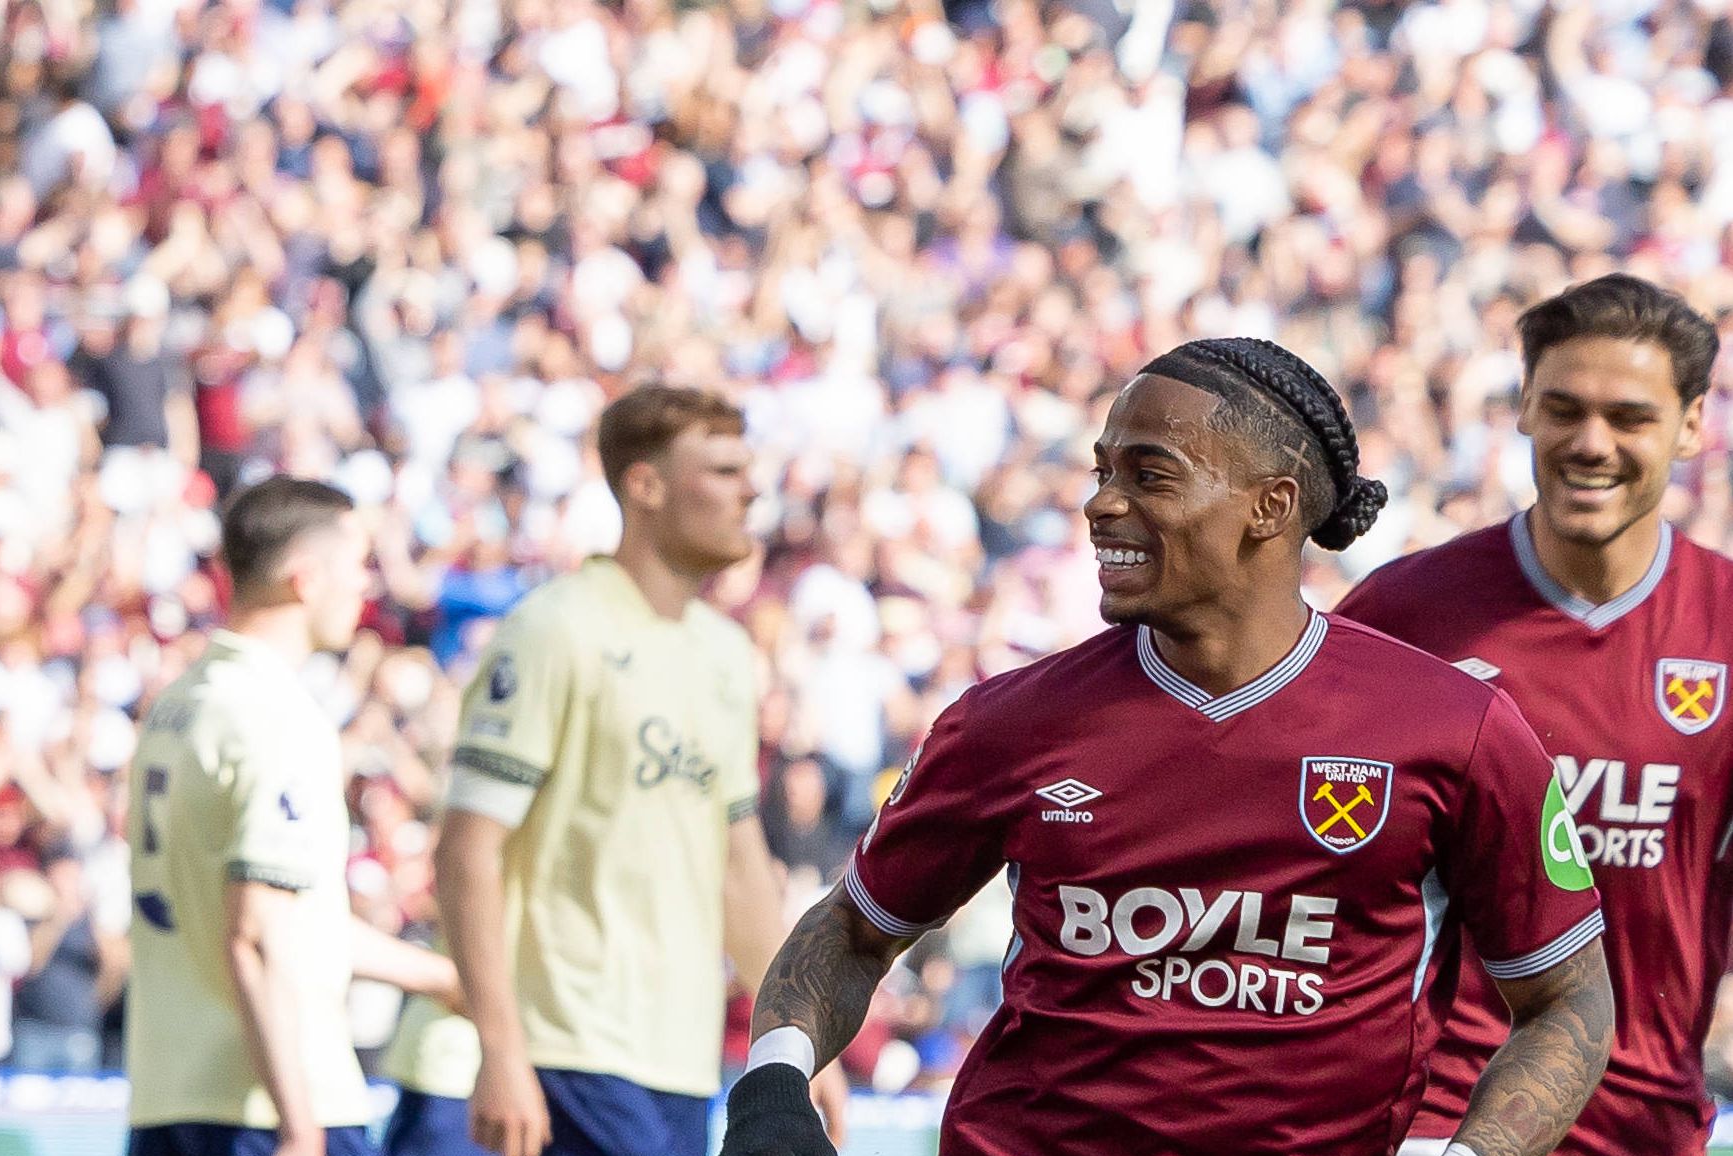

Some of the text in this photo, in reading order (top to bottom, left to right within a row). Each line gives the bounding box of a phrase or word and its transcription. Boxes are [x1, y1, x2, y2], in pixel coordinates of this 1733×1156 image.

[1311, 762, 1382, 779] WEST HAM
[1325, 771, 1367, 783] UNITED
[1555, 755, 1681, 823] YLE
[1041, 809, 1094, 823] umbro
[1577, 824, 1665, 869] ORTS
[1058, 884, 1338, 964] BOYLE
[1131, 956, 1325, 1016] SPORTS
